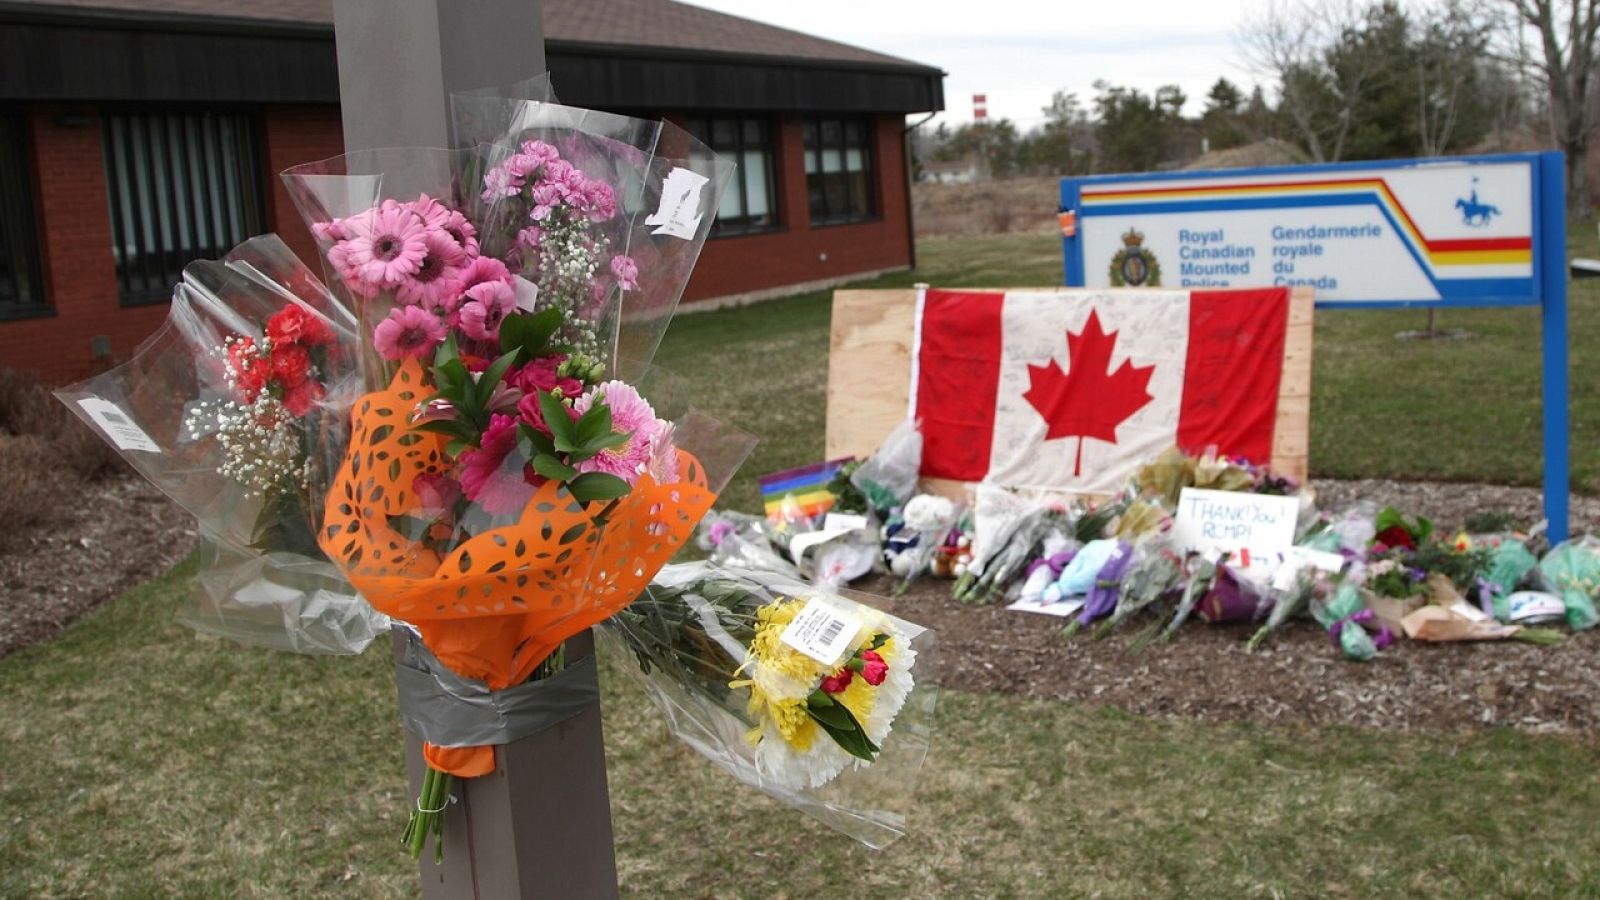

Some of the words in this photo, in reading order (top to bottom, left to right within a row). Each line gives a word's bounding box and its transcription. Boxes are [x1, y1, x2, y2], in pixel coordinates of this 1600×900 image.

[1179, 228, 1223, 245] Royal
[1271, 223, 1382, 240] Gendarmerie
[1179, 245, 1255, 259] Canadian
[1272, 243, 1323, 260] royale
[1180, 260, 1250, 275] Mounted
[1273, 261, 1295, 273] du
[1274, 275, 1337, 289] Canada
